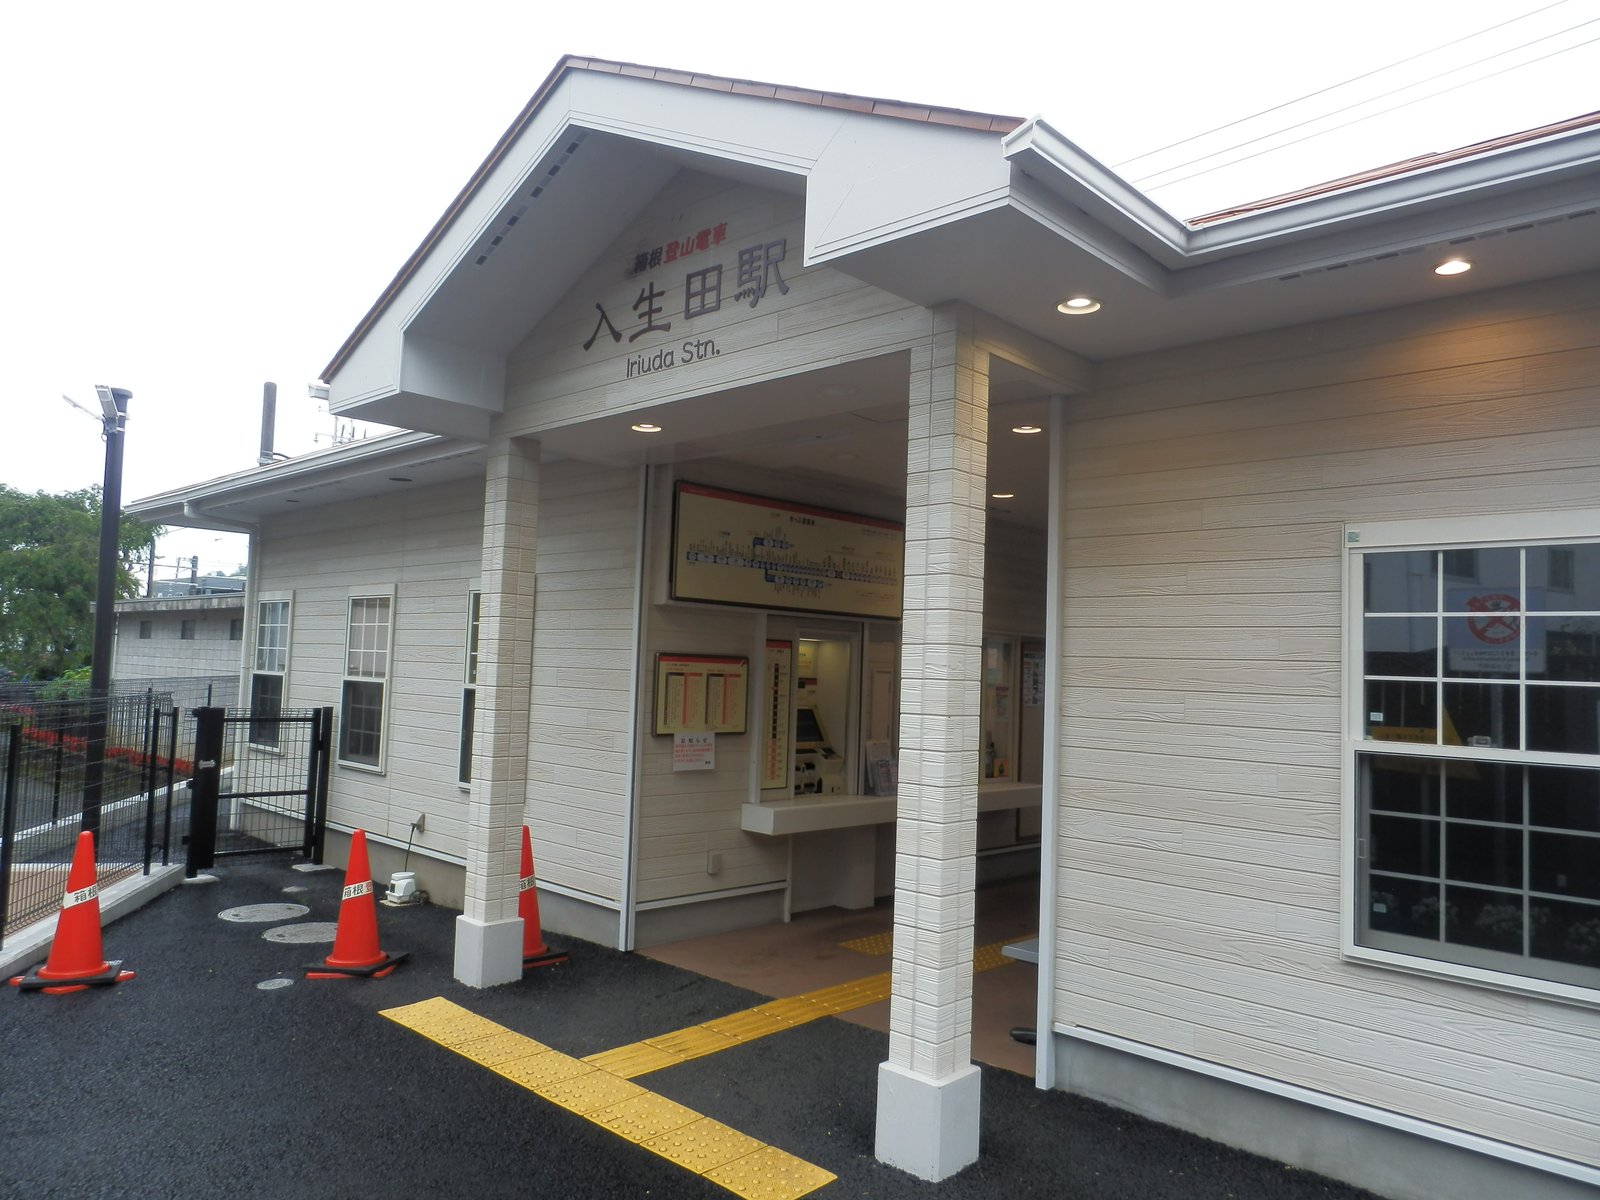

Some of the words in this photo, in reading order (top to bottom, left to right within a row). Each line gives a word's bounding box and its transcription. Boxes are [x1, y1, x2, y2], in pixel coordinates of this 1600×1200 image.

[633, 223, 728, 274] 箱根登山電車
[582, 238, 790, 351] 入生田駅
[625, 348, 674, 378] Iriuda
[681, 338, 721, 364] Stn.
